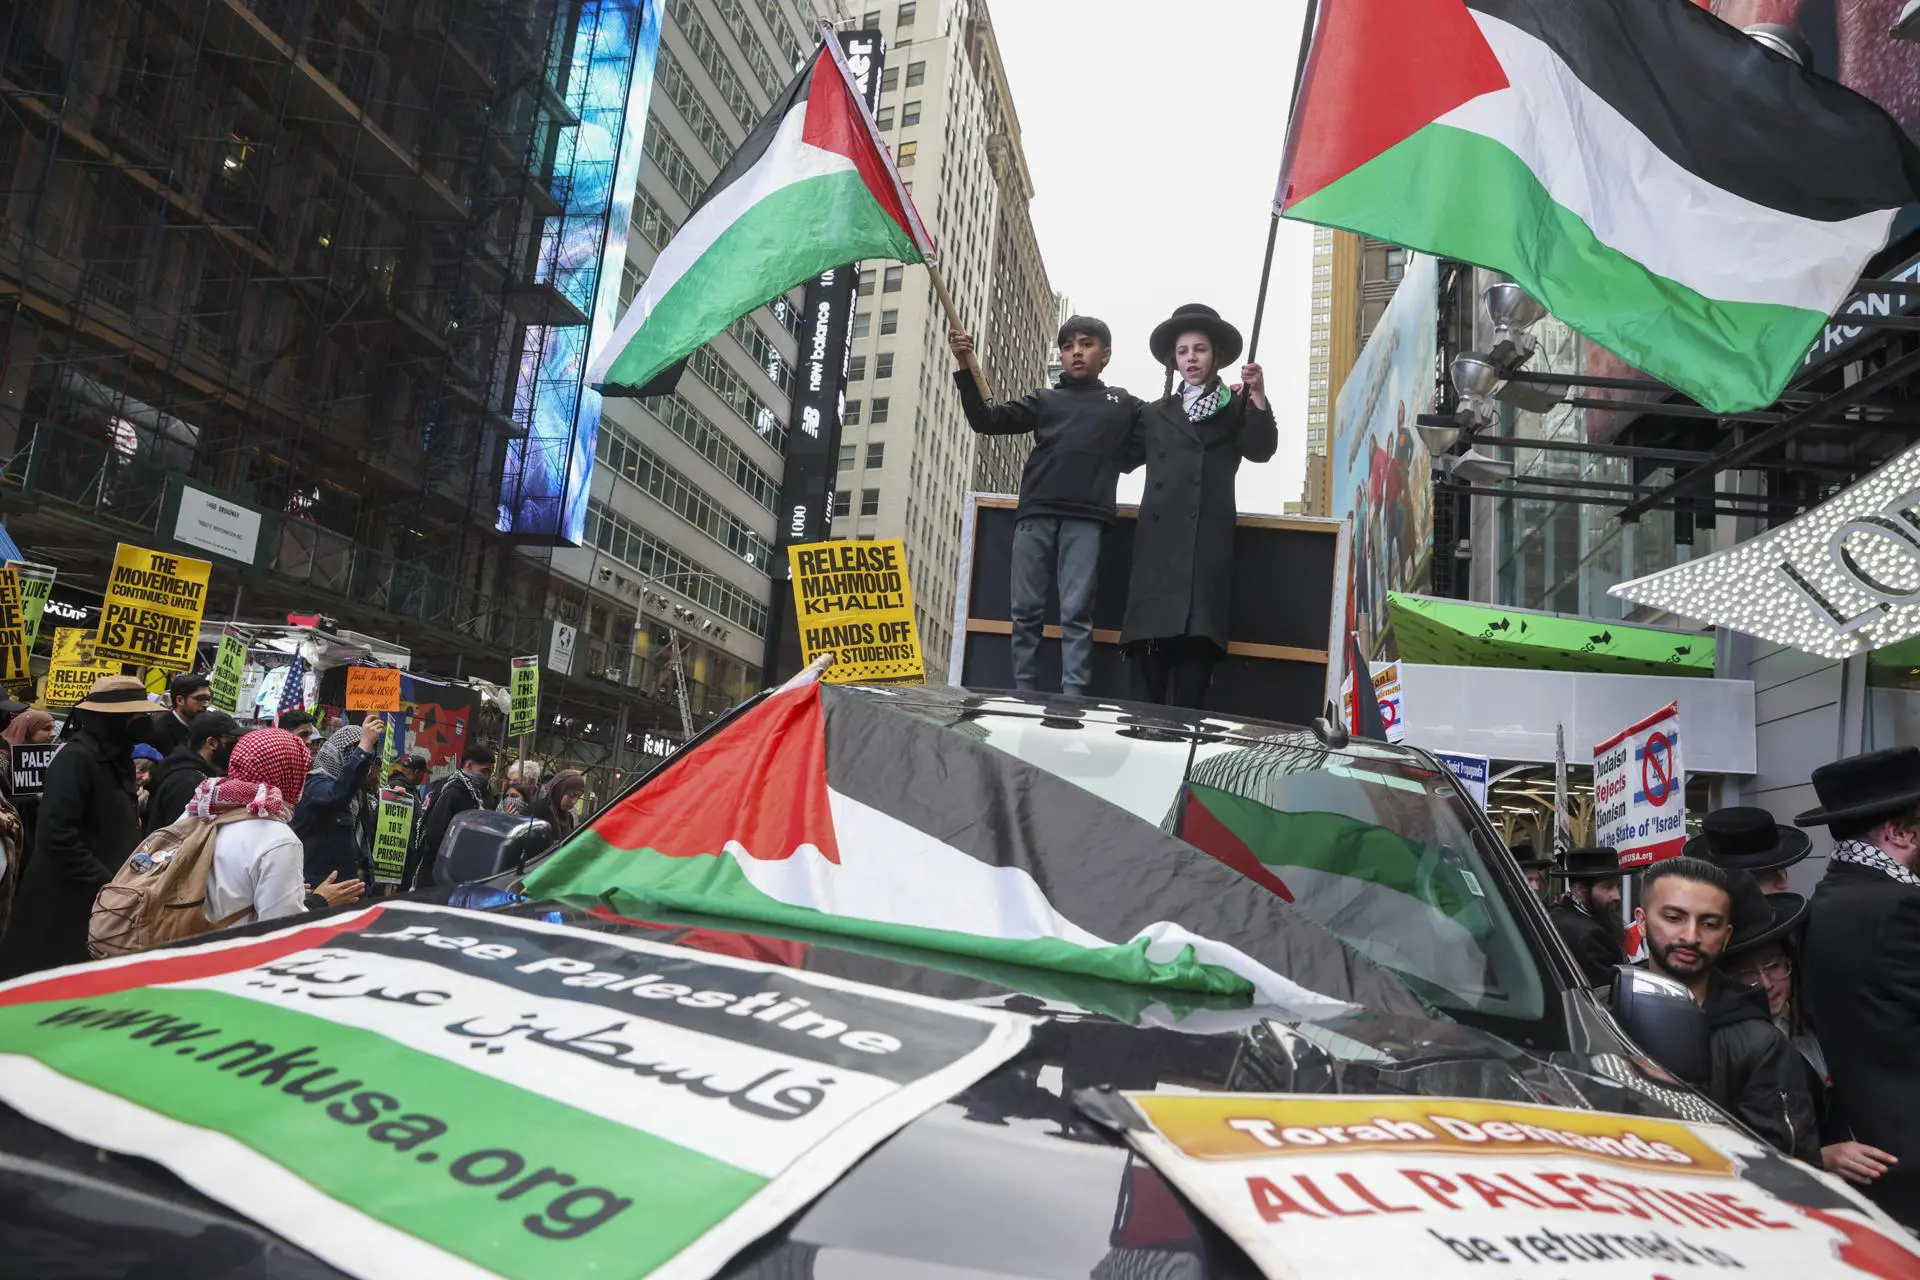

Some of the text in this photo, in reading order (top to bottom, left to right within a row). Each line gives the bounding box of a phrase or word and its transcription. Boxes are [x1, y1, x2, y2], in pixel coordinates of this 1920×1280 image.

[810, 301, 831, 391] new balance
[791, 505, 807, 538] 1000
[151, 555, 178, 576] THE
[798, 546, 898, 576] RELEASE
[112, 583, 199, 611] CONTINUES UNTIL
[115, 565, 204, 599] MOVEMENT
[801, 572, 902, 598] MAHMOUD
[804, 593, 905, 615] KHALIL!
[106, 604, 196, 637] PALESTINE
[806, 621, 911, 650] HANDS OFF
[101, 622, 192, 660] IS FREE!
[841, 644, 915, 664] STUDENTS!
[517, 683, 534, 696] THE
[518, 670, 534, 682] END
[14, 770, 43, 787] WILL
[1595, 773, 1627, 803] Rejects
[1596, 801, 1626, 829] Zionism
[1606, 832, 1615, 846] the
[1616, 823, 1636, 843] State
[1638, 818, 1650, 837] of
[1652, 808, 1684, 834] "Israel"
[360, 925, 902, 1054] Free Palestine
[246, 953, 838, 1121] فلسطين عربية
[37, 1005, 634, 1241] www.nkusa.org
[1228, 1113, 1694, 1165] Torah Demands
[1246, 1169, 1799, 1230] ALL PALESTINE
[1426, 1226, 1747, 1269] be returned to
